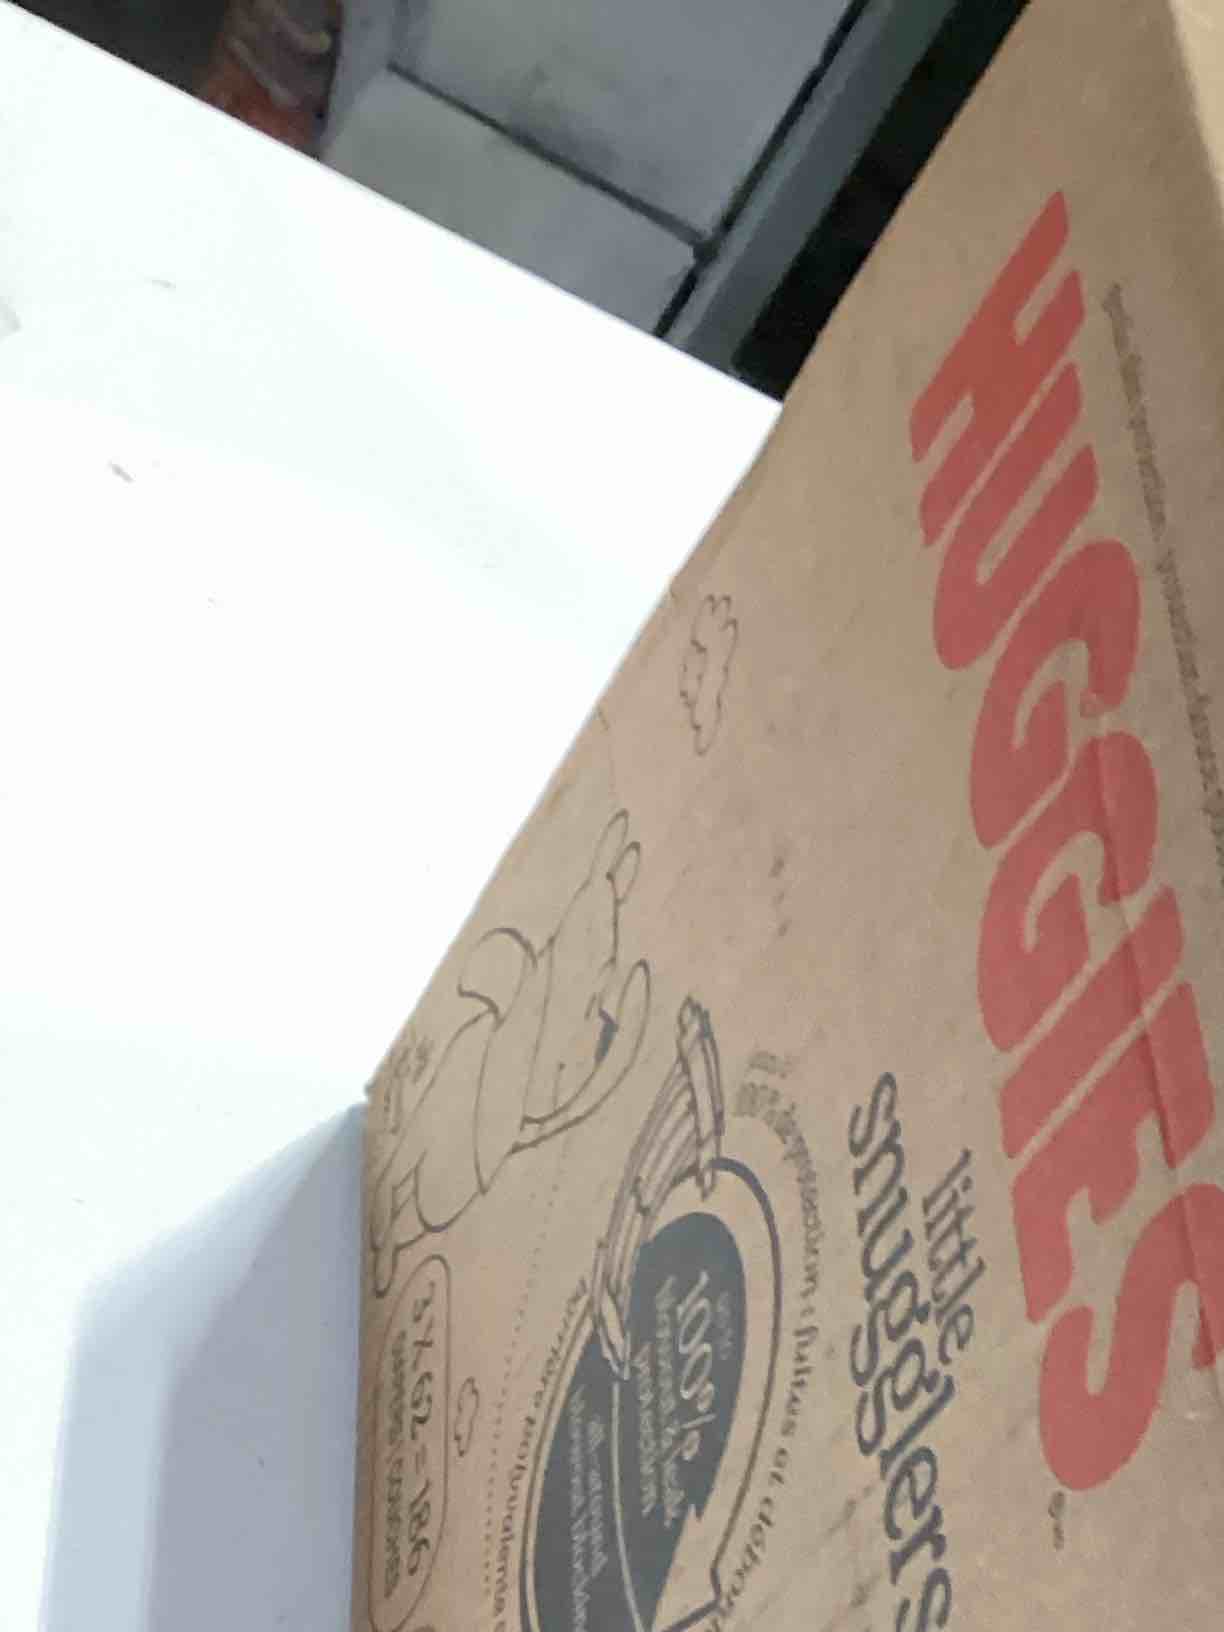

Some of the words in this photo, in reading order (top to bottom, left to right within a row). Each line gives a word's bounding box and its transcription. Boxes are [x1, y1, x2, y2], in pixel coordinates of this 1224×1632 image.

[412, 1280, 436, 1323] 3
[921, 1148, 985, 1365] little
[410, 1371, 433, 1441] 62
[635, 1341, 658, 1517] protection
[677, 1270, 718, 1462] 100%
[407, 1480, 431, 1577] 186
